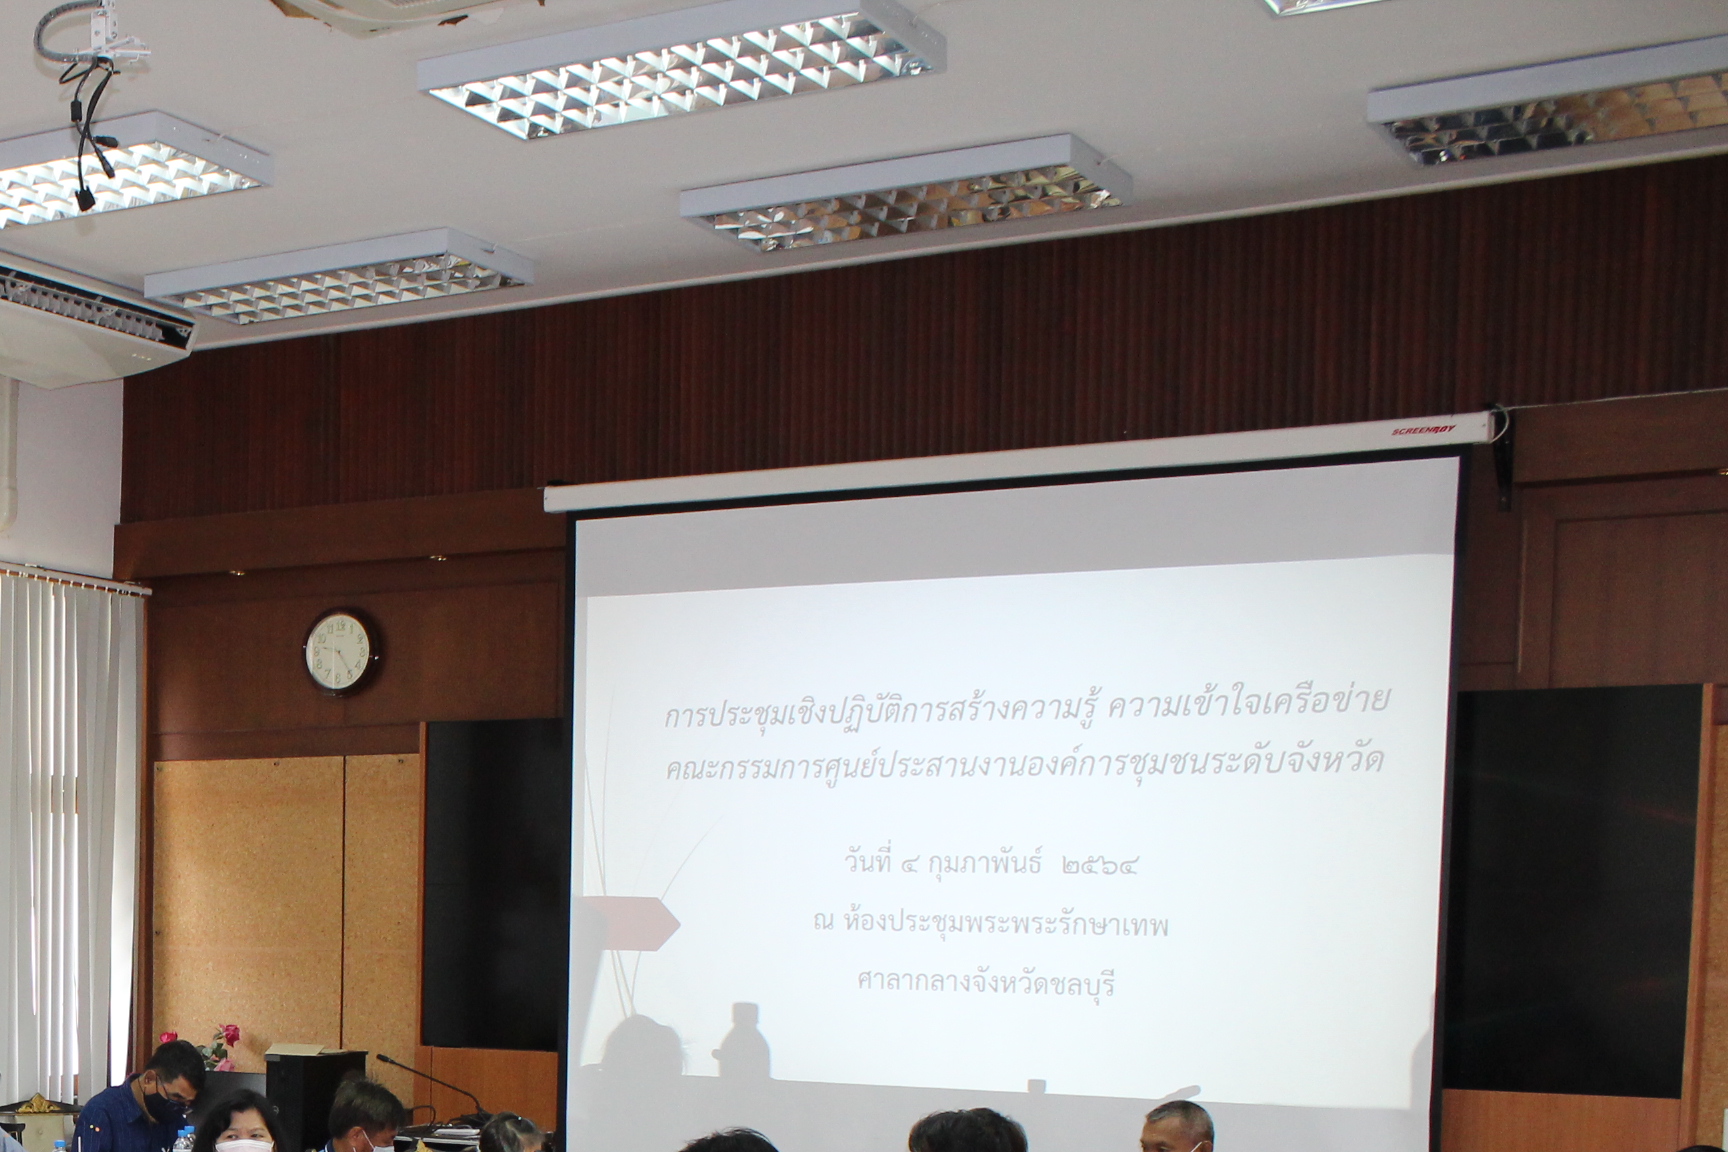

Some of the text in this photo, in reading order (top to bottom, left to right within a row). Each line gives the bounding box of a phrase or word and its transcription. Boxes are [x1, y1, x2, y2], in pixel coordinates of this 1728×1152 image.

[664, 679, 1392, 737] การประชุมเชิงปฏิบัติการสร้างความรู้ ความเข้าใจเครือข่าย
[665, 738, 1385, 788] คณะกรรมการศูนย์ประสานงานองค์การชุมชนระดับจังหวัด
[844, 839, 1140, 883] วันที่ ๔ กุมภาพันธ์ ๒๕๖๔
[813, 903, 1170, 942] ณ ห้องประชุมพระพระรักษาเทพ
[857, 966, 1116, 1006] ศาลากลางจังหวัดชลบุรี
